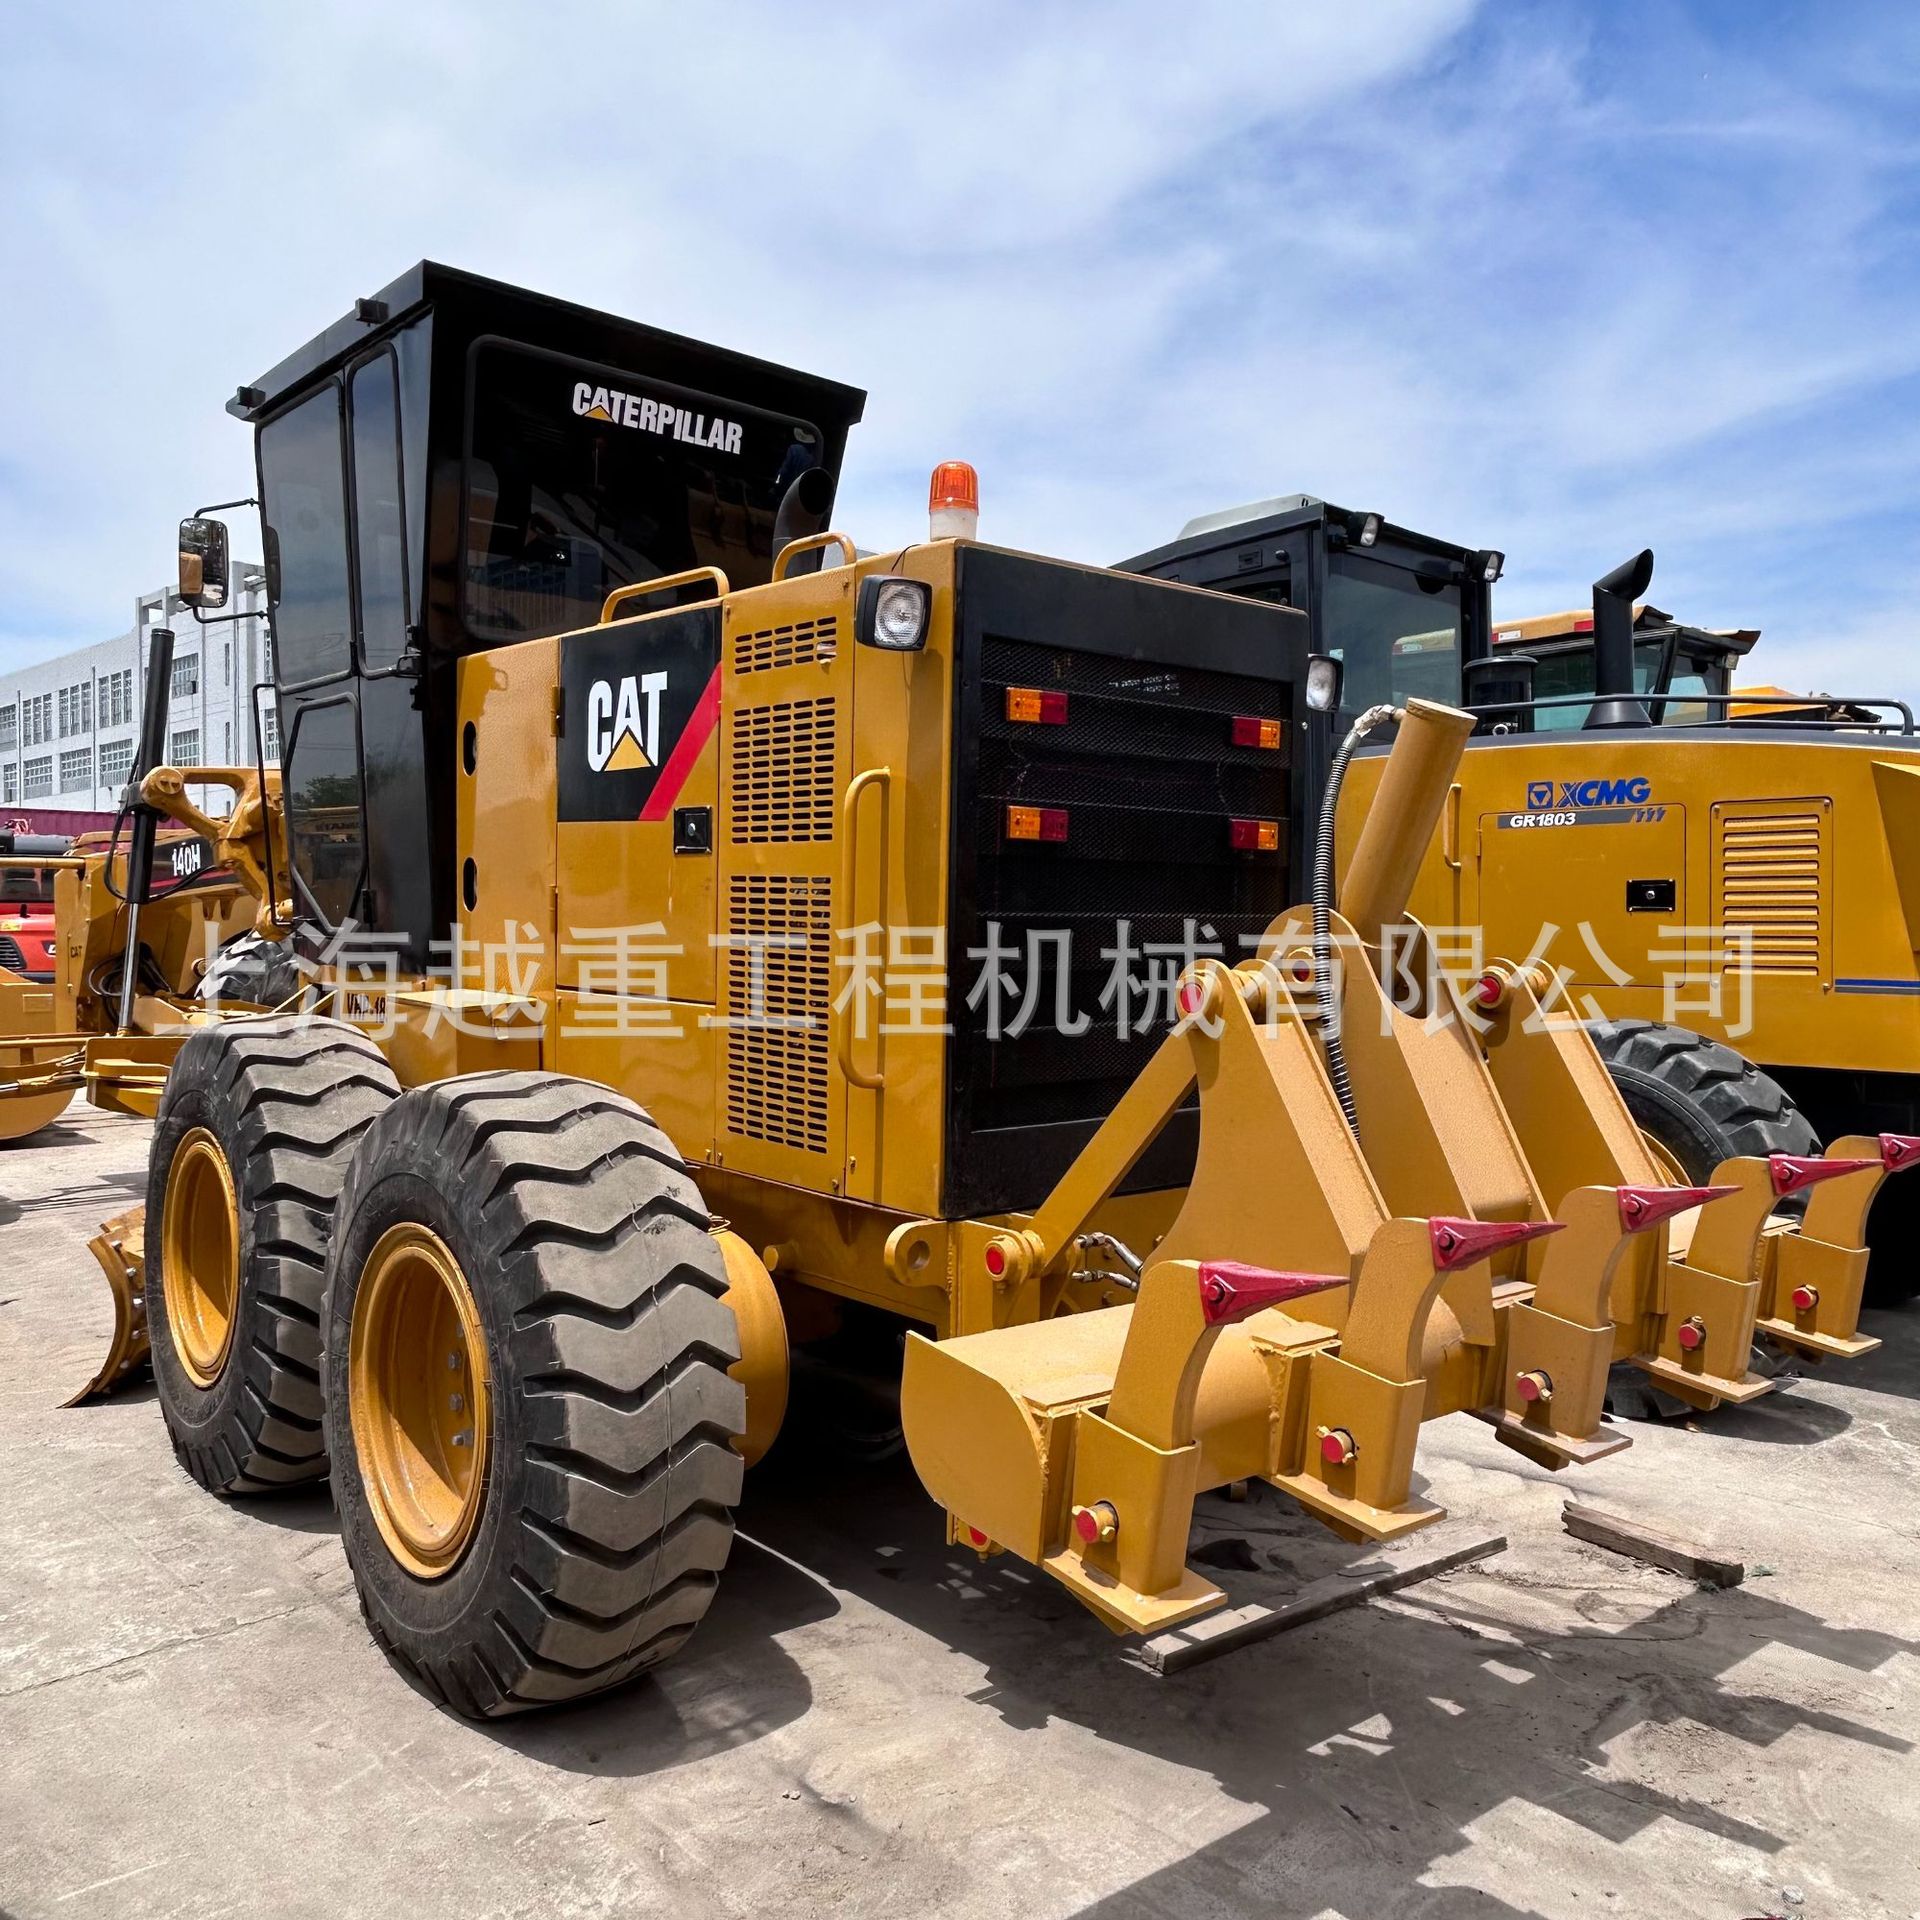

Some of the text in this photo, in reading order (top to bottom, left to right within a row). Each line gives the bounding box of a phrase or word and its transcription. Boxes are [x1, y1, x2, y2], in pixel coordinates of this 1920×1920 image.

[572, 382, 743, 455] CATERPILLAR
[587, 670, 668, 772] CAT
[1554, 777, 1651, 808] XCMG
[1510, 813, 1576, 827] GR1803
[171, 843, 201, 877] 140H
